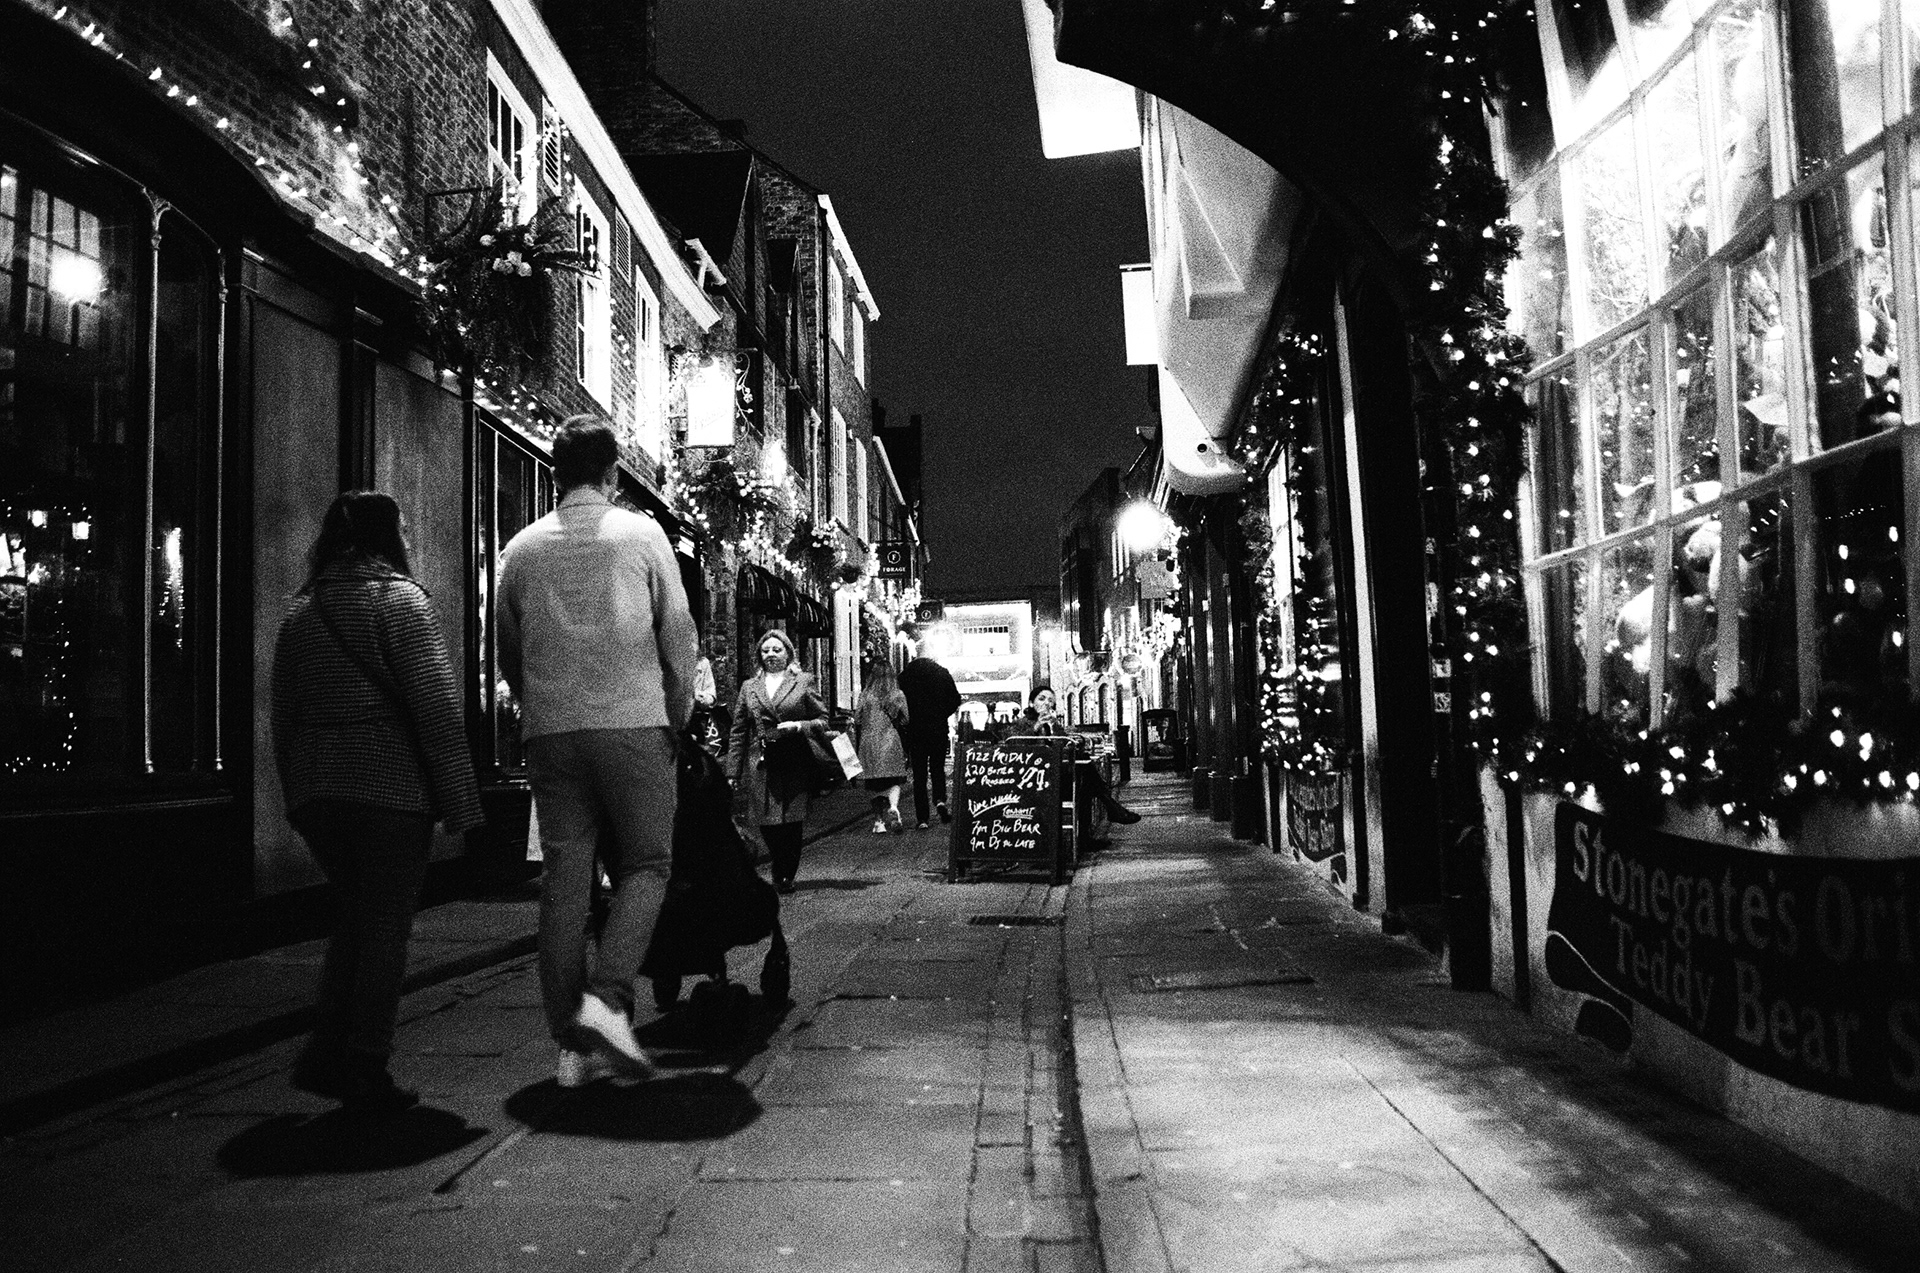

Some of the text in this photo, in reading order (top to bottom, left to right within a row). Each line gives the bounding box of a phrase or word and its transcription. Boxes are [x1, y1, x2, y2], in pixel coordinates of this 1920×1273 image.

[965, 763, 986, 777] £20
[1572, 820, 1920, 964] Stonegate's Ori
[1609, 914, 1715, 1032] Teddy
[1733, 958, 1861, 1078] Bear
